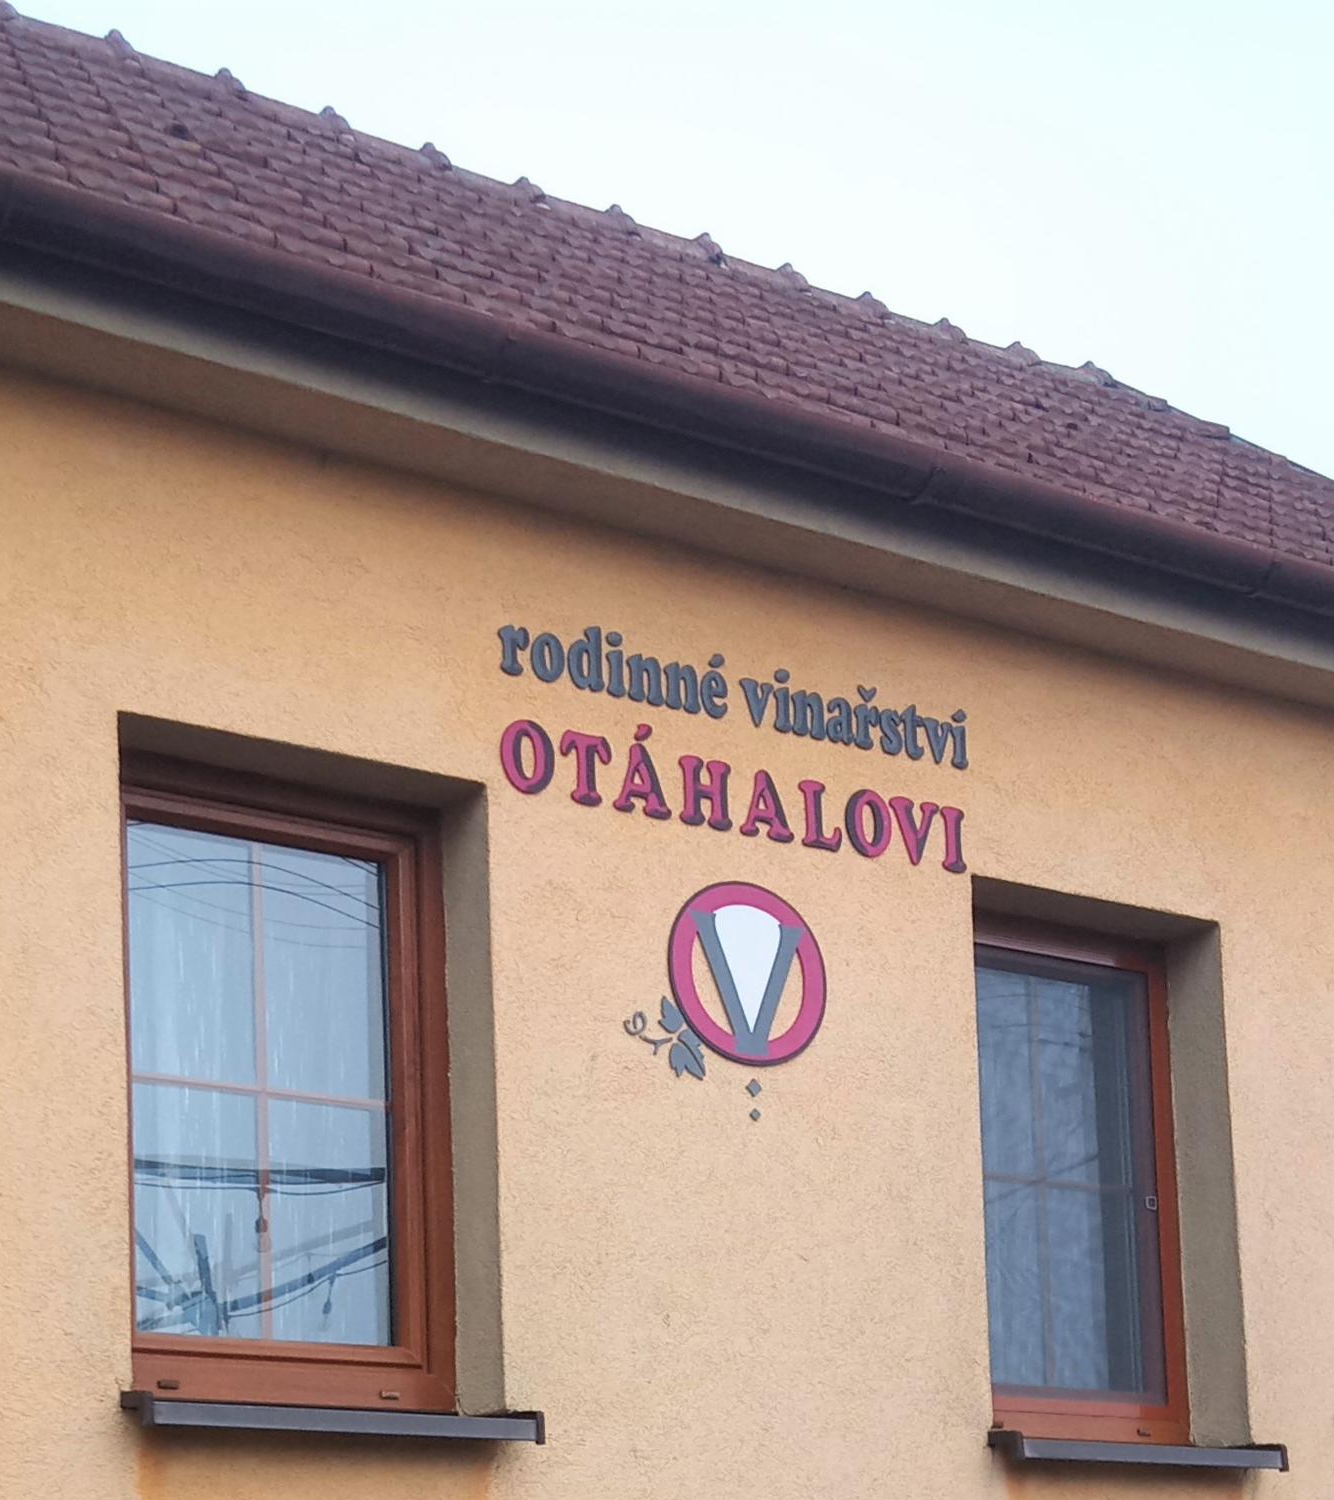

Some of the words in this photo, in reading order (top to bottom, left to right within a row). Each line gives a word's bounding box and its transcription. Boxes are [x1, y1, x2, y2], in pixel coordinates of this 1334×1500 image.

[497, 624, 728, 719] rodinné
[740, 669, 968, 769] vinařství
[500, 719, 967, 873] OTÁHALOVI
